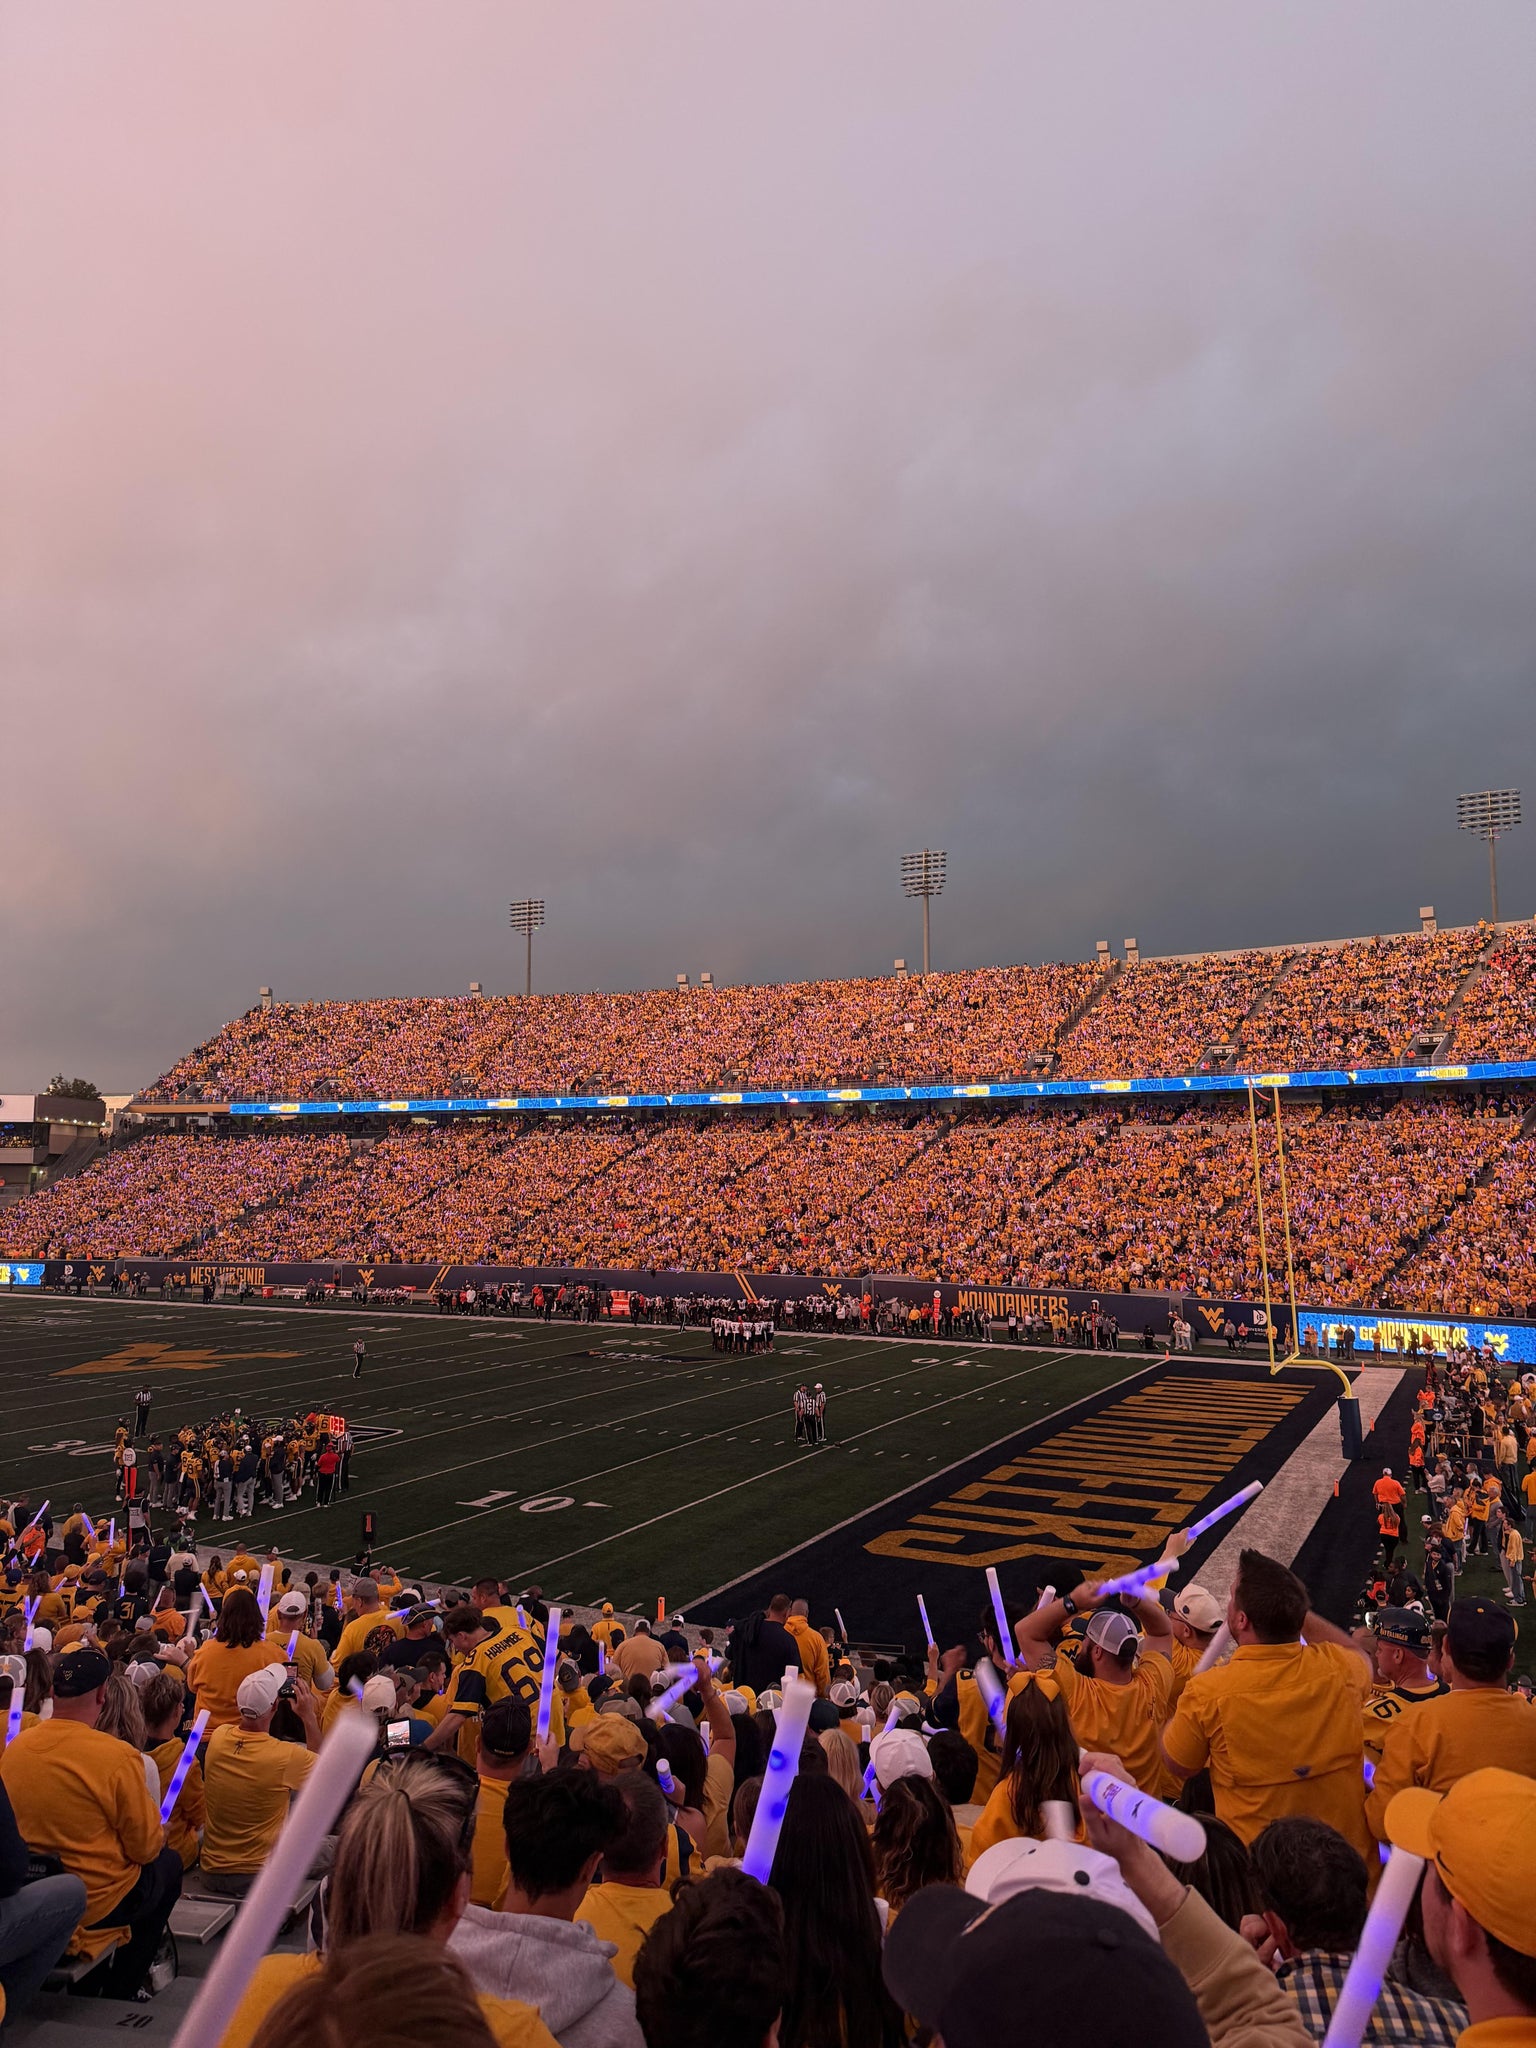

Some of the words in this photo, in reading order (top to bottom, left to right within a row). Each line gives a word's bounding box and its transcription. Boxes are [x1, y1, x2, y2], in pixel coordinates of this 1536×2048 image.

[190, 1266, 217, 1285] WEST
[958, 1290, 1069, 1323] MOUNTAINEERS
[454, 1489, 576, 1513] 10
[365, 1514, 373, 1533] 1
[119, 1601, 136, 1620] 31
[484, 1631, 524, 1660] HARAMBE
[116, 2012, 154, 2029] 20
